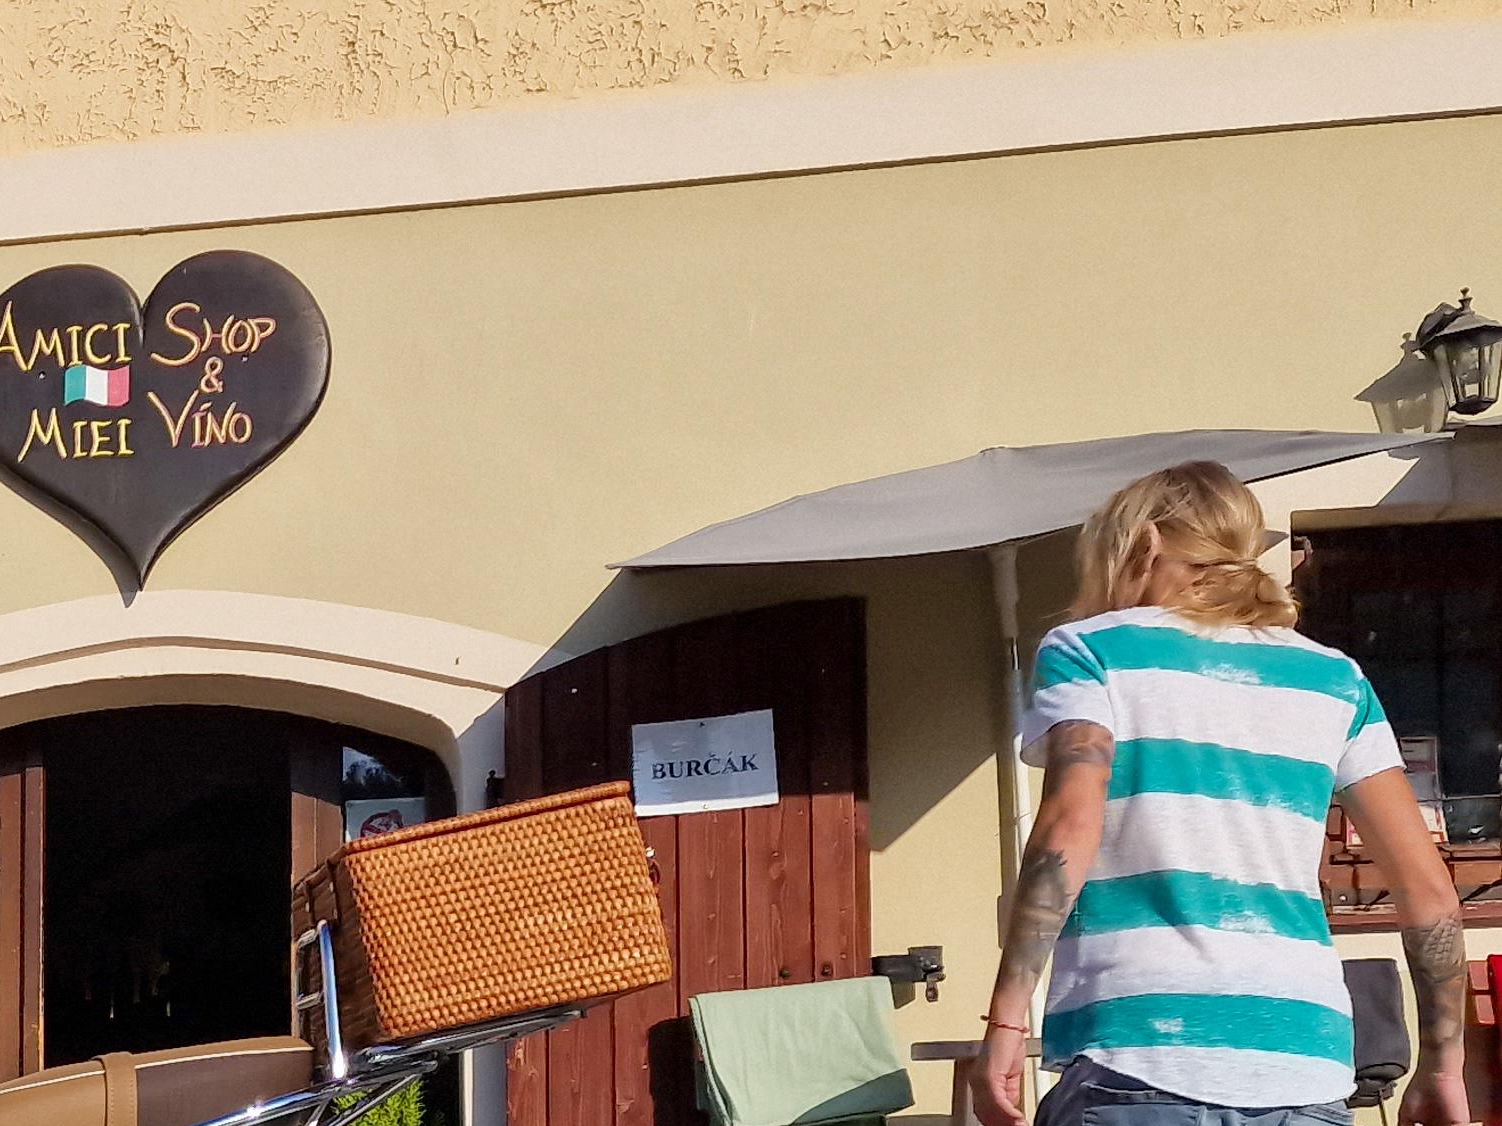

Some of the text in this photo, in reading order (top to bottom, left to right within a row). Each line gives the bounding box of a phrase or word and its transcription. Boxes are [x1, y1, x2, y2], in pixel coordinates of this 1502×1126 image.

[200, 357, 224, 393] &
[17, 408, 135, 463] MIEI
[652, 750, 759, 780] BURČÁK
